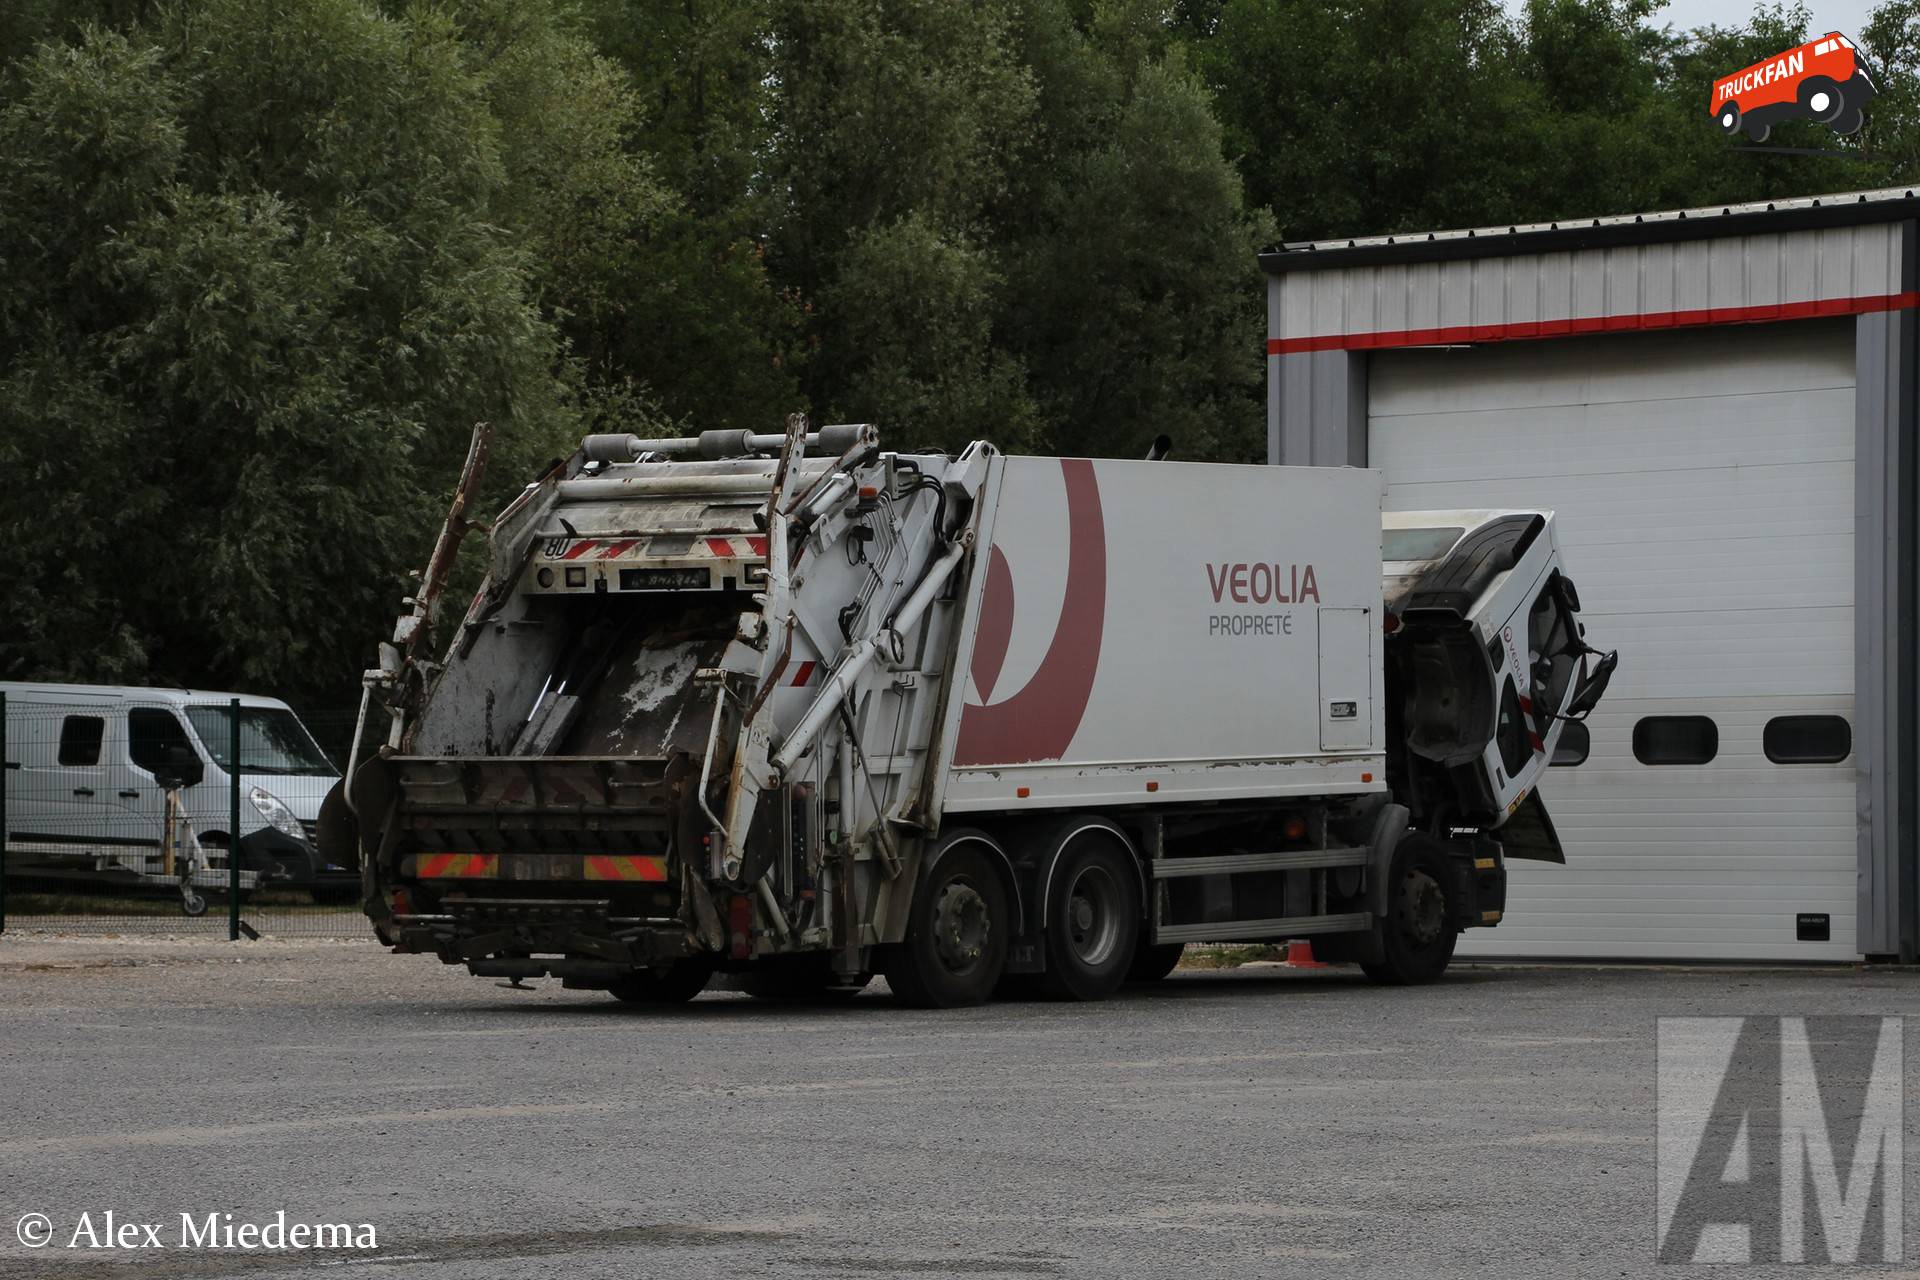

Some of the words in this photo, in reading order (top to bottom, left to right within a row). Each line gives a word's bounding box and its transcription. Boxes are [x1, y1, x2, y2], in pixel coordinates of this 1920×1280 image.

[545, 537, 570, 556] 80
[1206, 562, 1320, 604] VEOLIA
[1209, 610, 1292, 636] PROPRETÉ
[1510, 642, 1524, 687] VEOLIA
